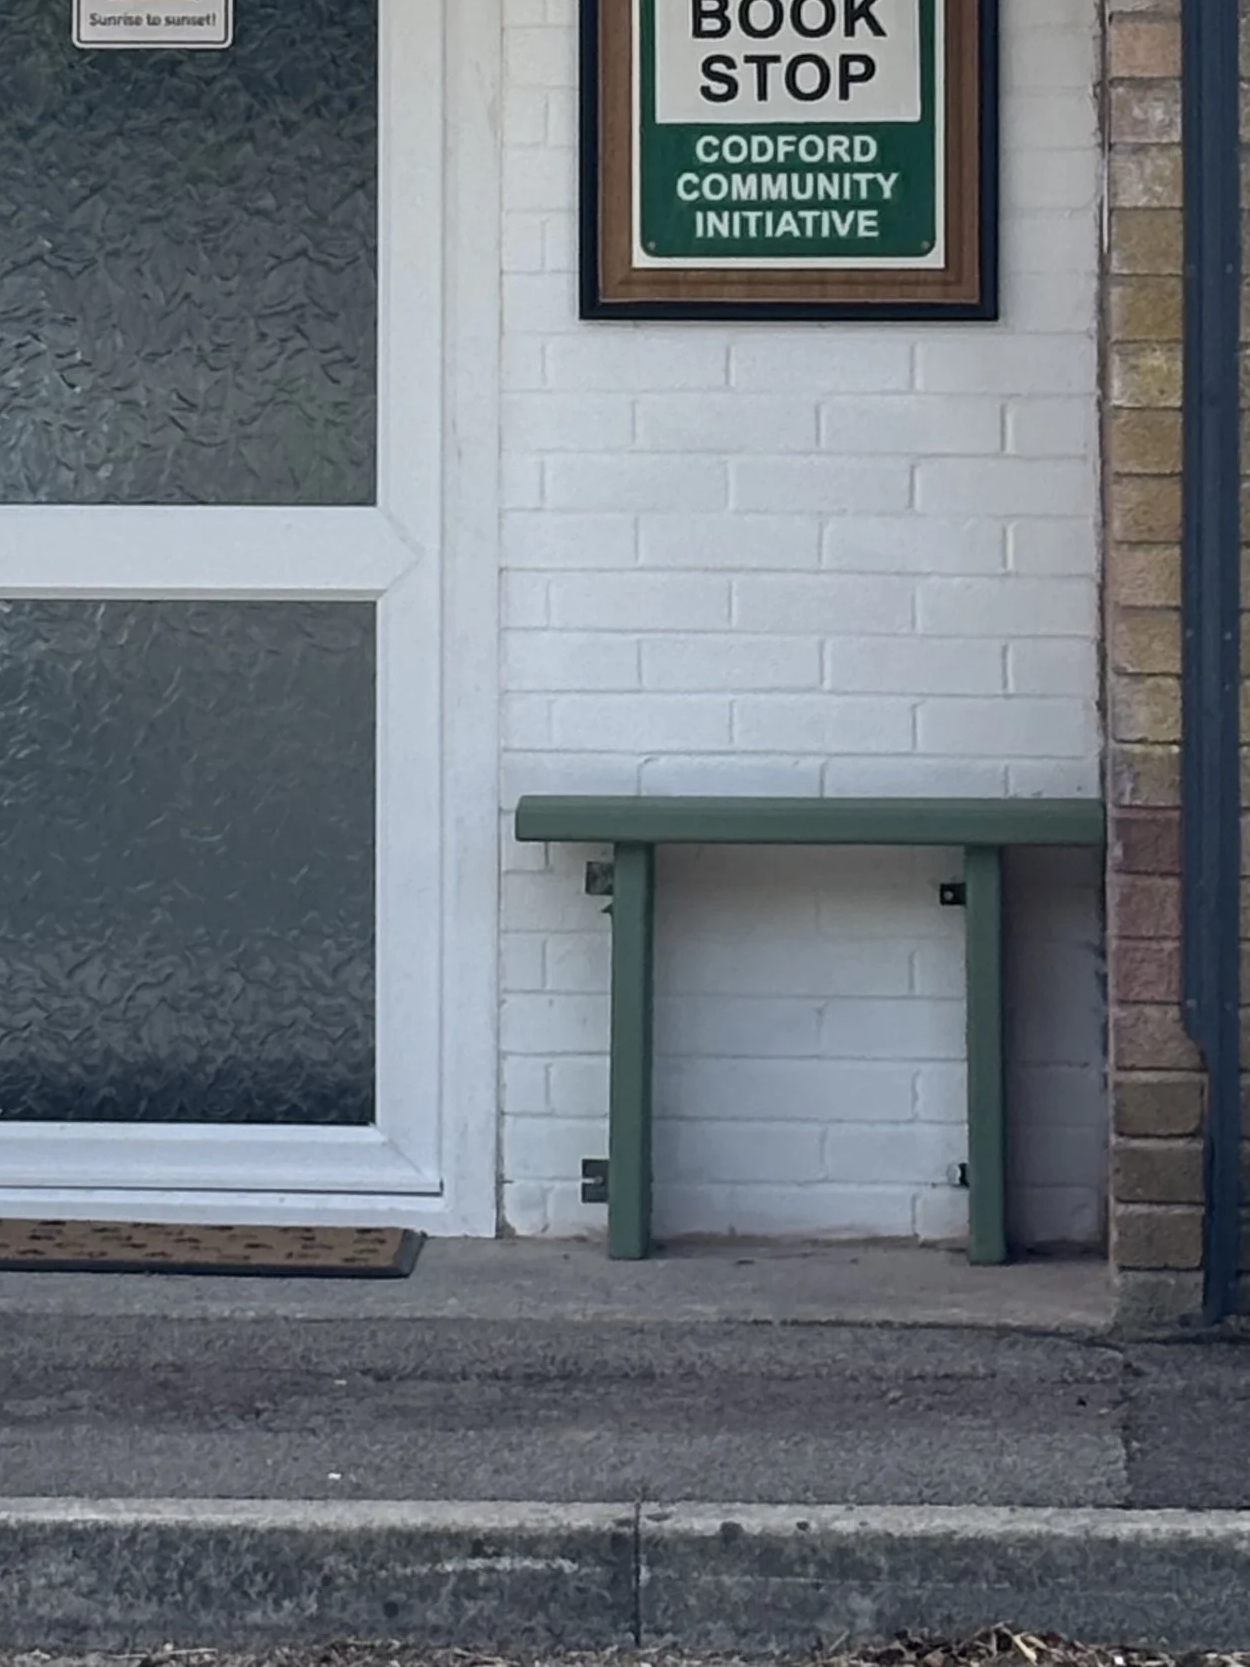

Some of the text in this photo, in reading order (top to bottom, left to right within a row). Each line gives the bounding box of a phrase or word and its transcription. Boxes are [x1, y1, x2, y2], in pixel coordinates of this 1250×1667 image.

[89, 12, 217, 26] Sunrise to sunset!
[700, 53, 877, 104] STOP
[695, 135, 878, 164] CODFORD
[676, 172, 899, 201] COMMUNITY
[695, 209, 879, 239] INITIATIVE
